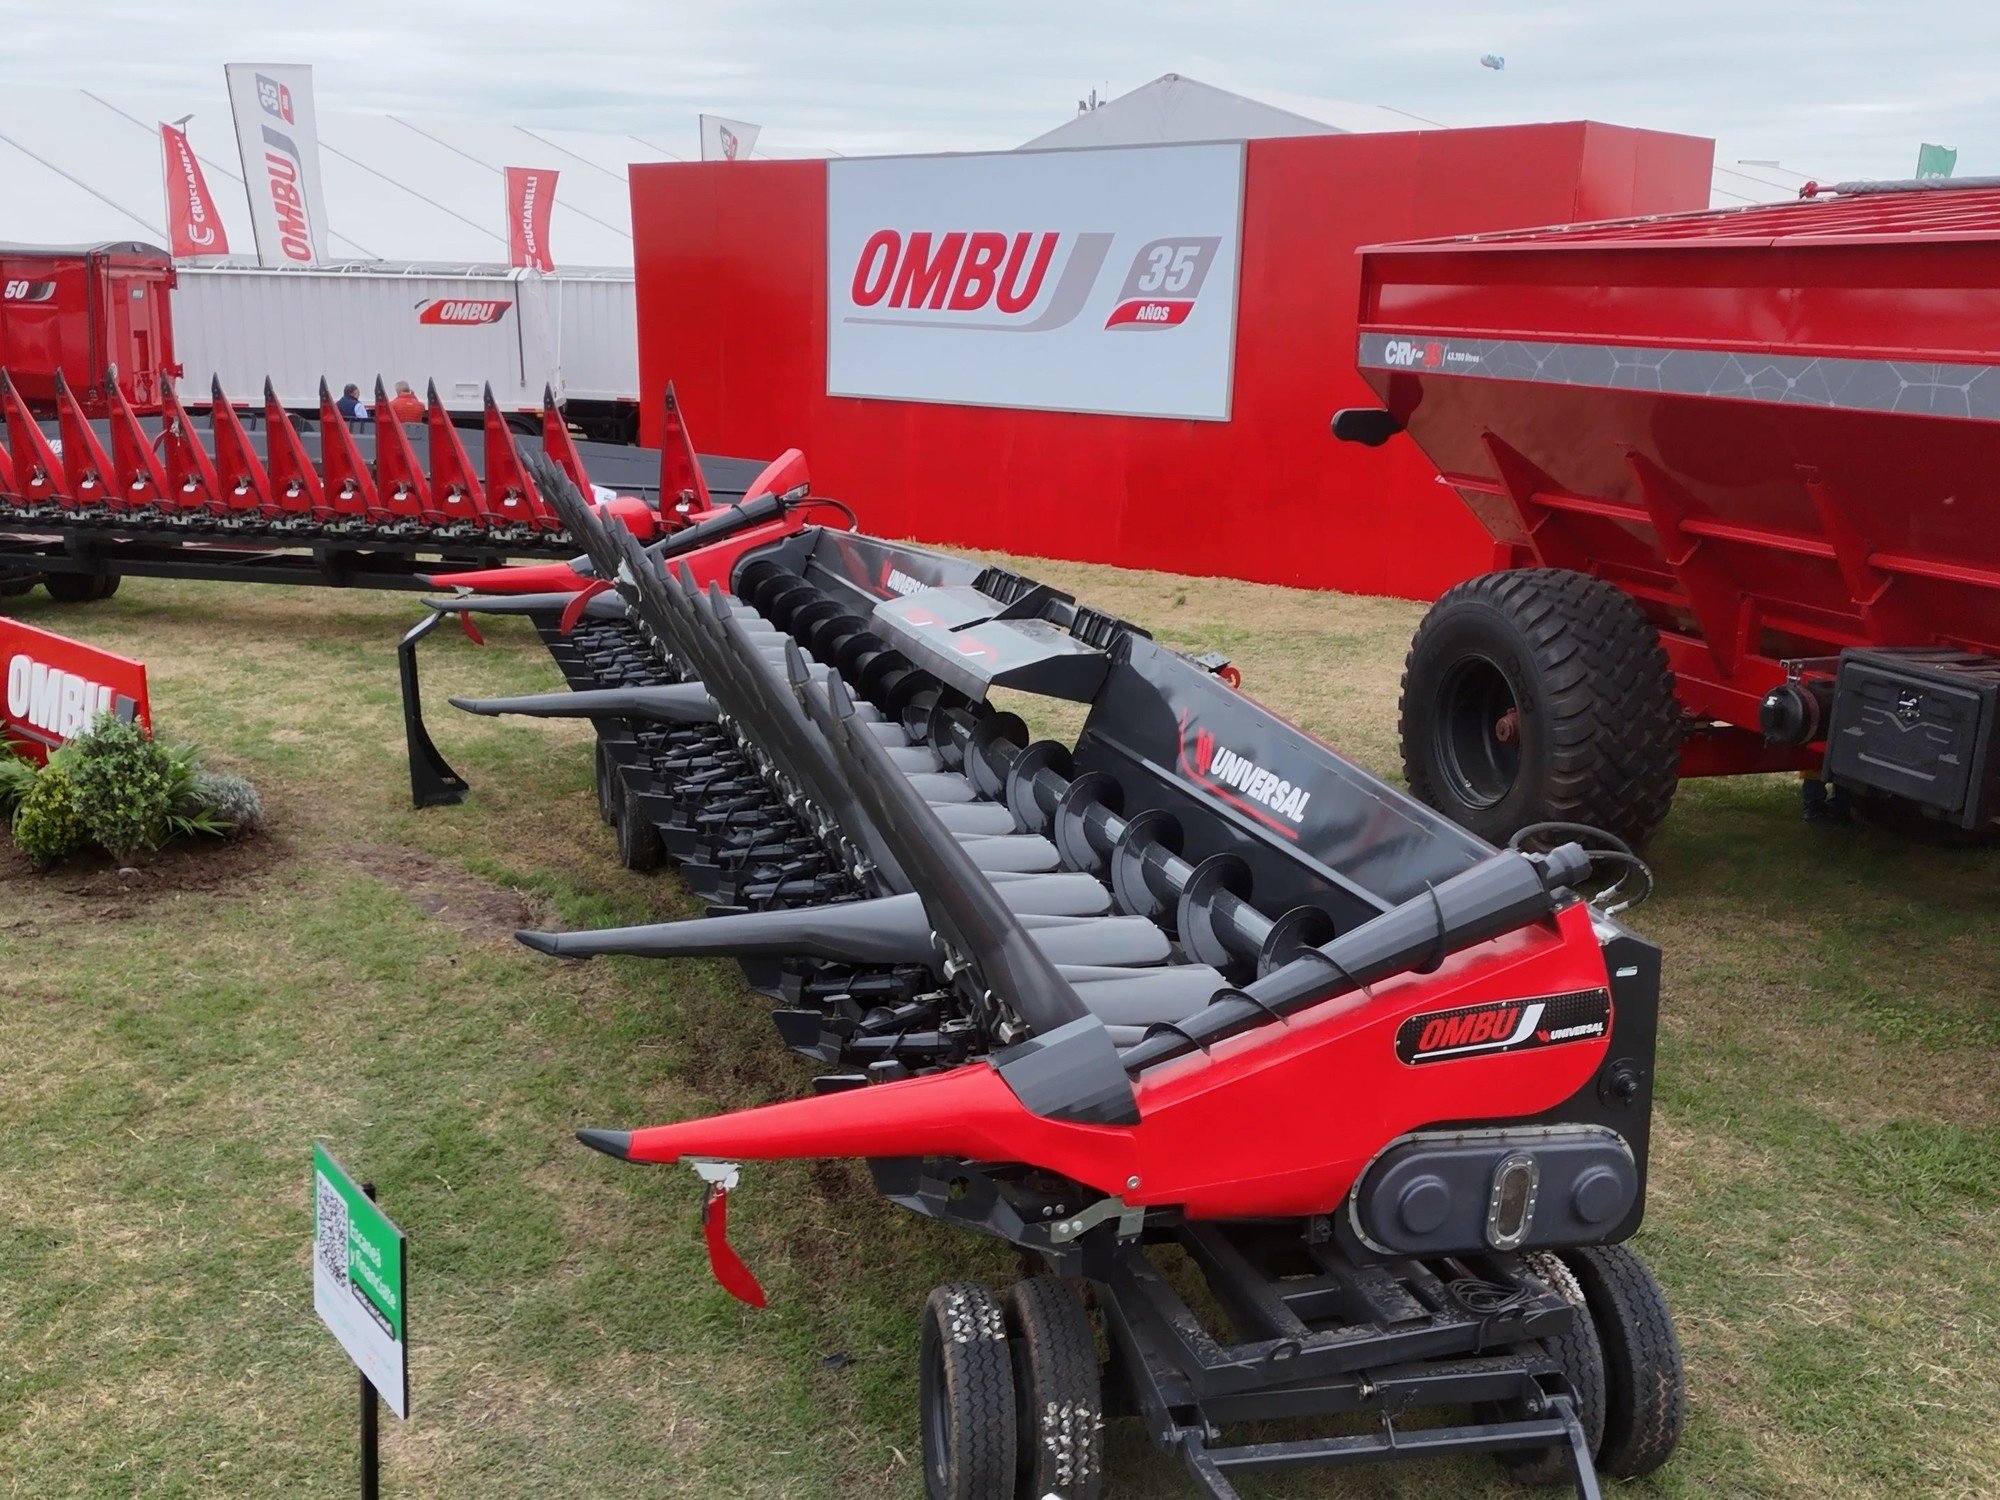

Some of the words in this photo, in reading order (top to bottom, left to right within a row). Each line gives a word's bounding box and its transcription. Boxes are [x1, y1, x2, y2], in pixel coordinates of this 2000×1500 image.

[265, 152, 312, 262] OMBU
[523, 175, 537, 254] CRUCIANELLI
[851, 229, 1061, 314] OMBU
[1138, 245, 1201, 292] 35
[440, 301, 496, 321] OMBU
[1136, 303, 1170, 320] AÑOS
[887, 568, 930, 596] UNIVERS
[7, 654, 113, 741] OMBU
[1210, 745, 1311, 824] UNIVERSAL
[1418, 1007, 1521, 1051] OMBU
[1550, 1022, 1605, 1041] UNIVERSAL
